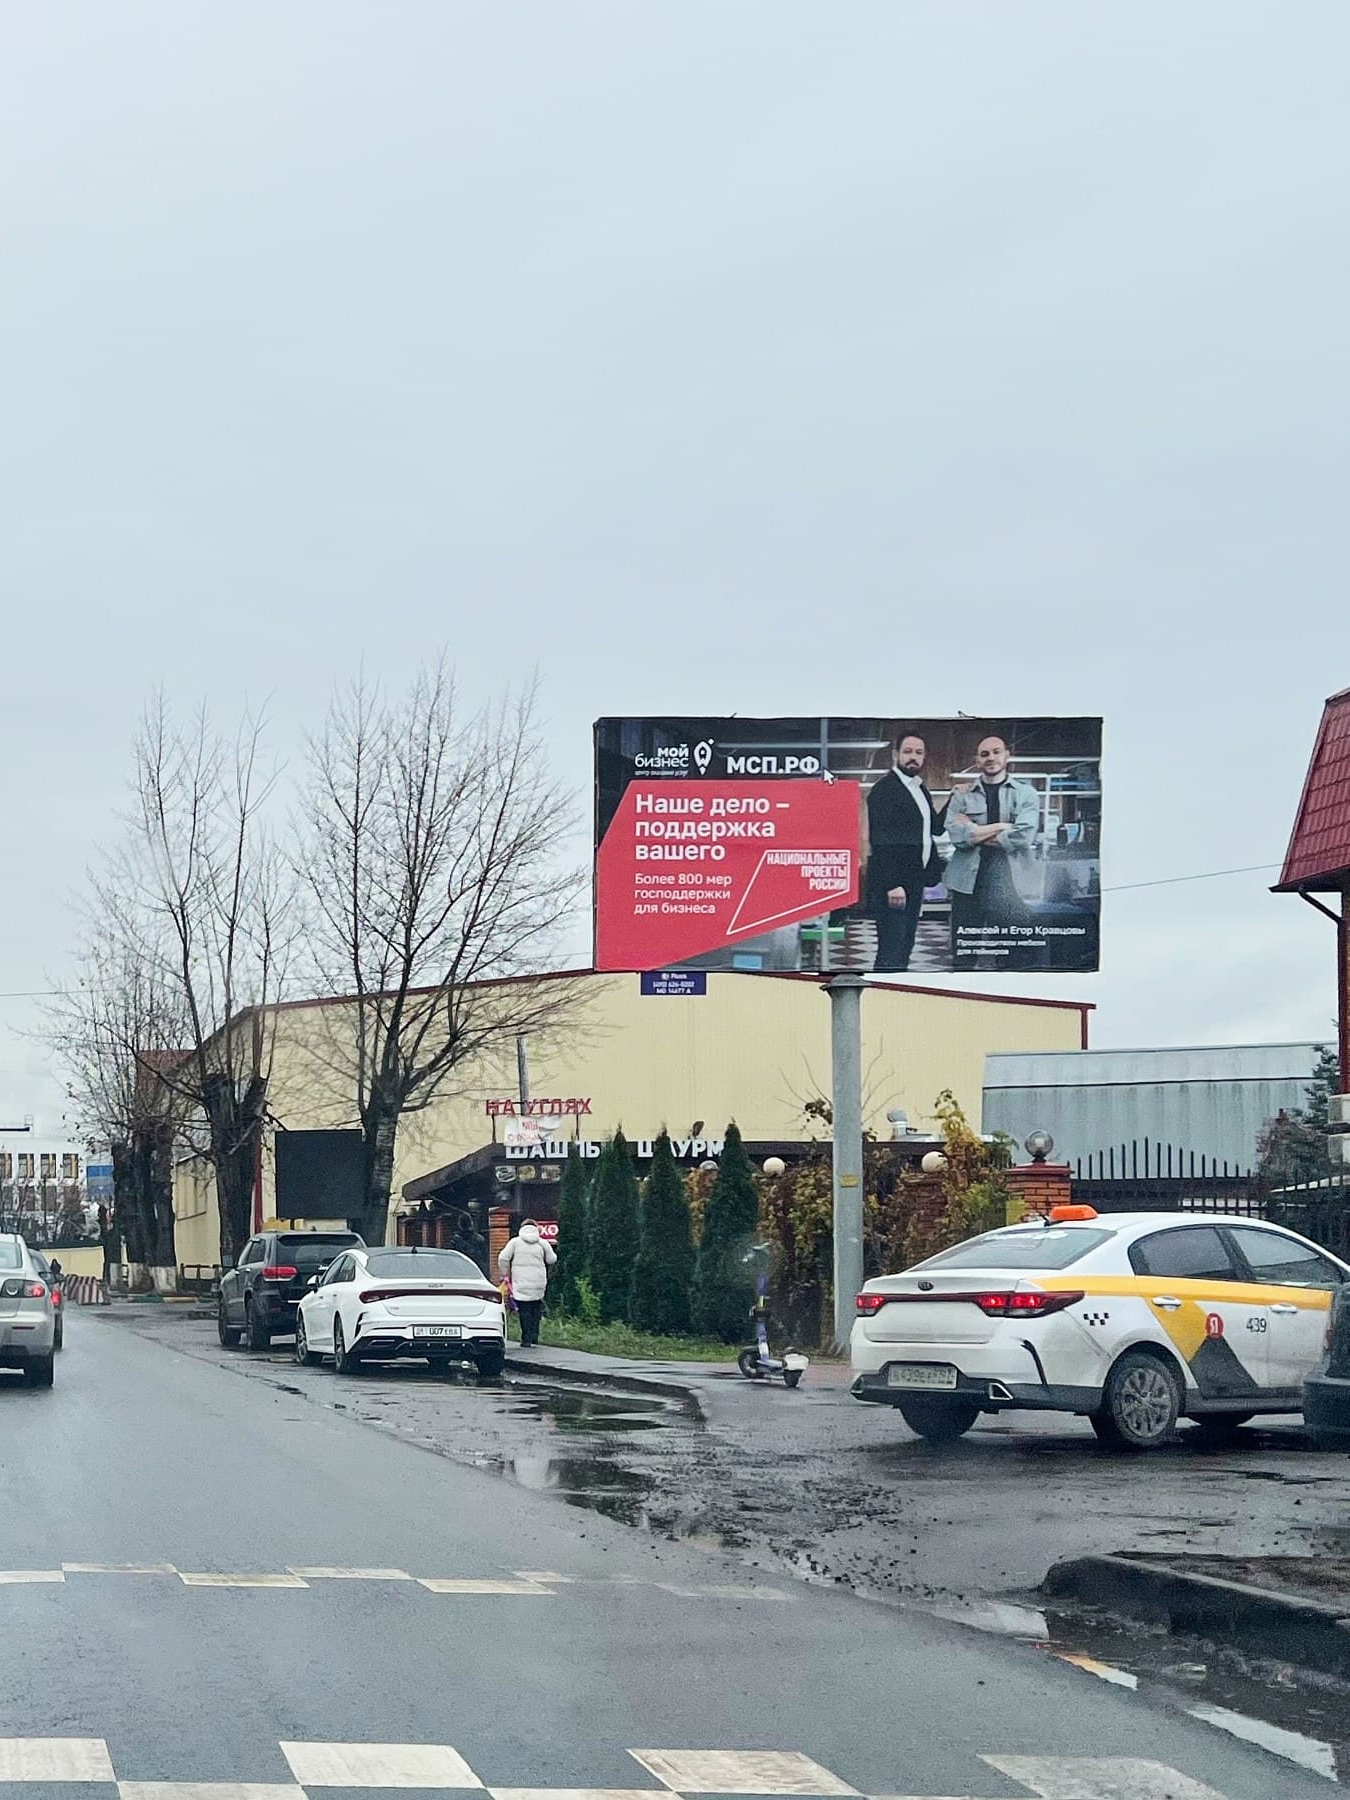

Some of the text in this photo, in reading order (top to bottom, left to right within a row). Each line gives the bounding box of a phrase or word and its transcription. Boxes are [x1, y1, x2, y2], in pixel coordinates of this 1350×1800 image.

[657, 744, 689, 758] мой
[634, 753, 690, 768] бизнес
[726, 755, 820, 775] МСП.РФ
[635, 794, 704, 814] Наше
[709, 798, 771, 817] дело
[635, 821, 776, 841] поддержка
[635, 844, 726, 861] вашего
[766, 853, 848, 866] НАЦИОНАЛЬНЫЕ
[634, 872, 733, 887] Более 800 мер
[801, 866, 848, 878] ПРОЕКТЫ
[809, 878, 848, 891] РОССИИ
[634, 889, 731, 901] господдержки
[634, 902, 716, 915] для бизнеса
[956, 926, 1000, 935] Алексей
[1009, 926, 1034, 936] Егор
[1035, 926, 1086, 936] Кравцовы
[485, 1099, 516, 1116] НА
[1246, 1317, 1268, 1333] 439
